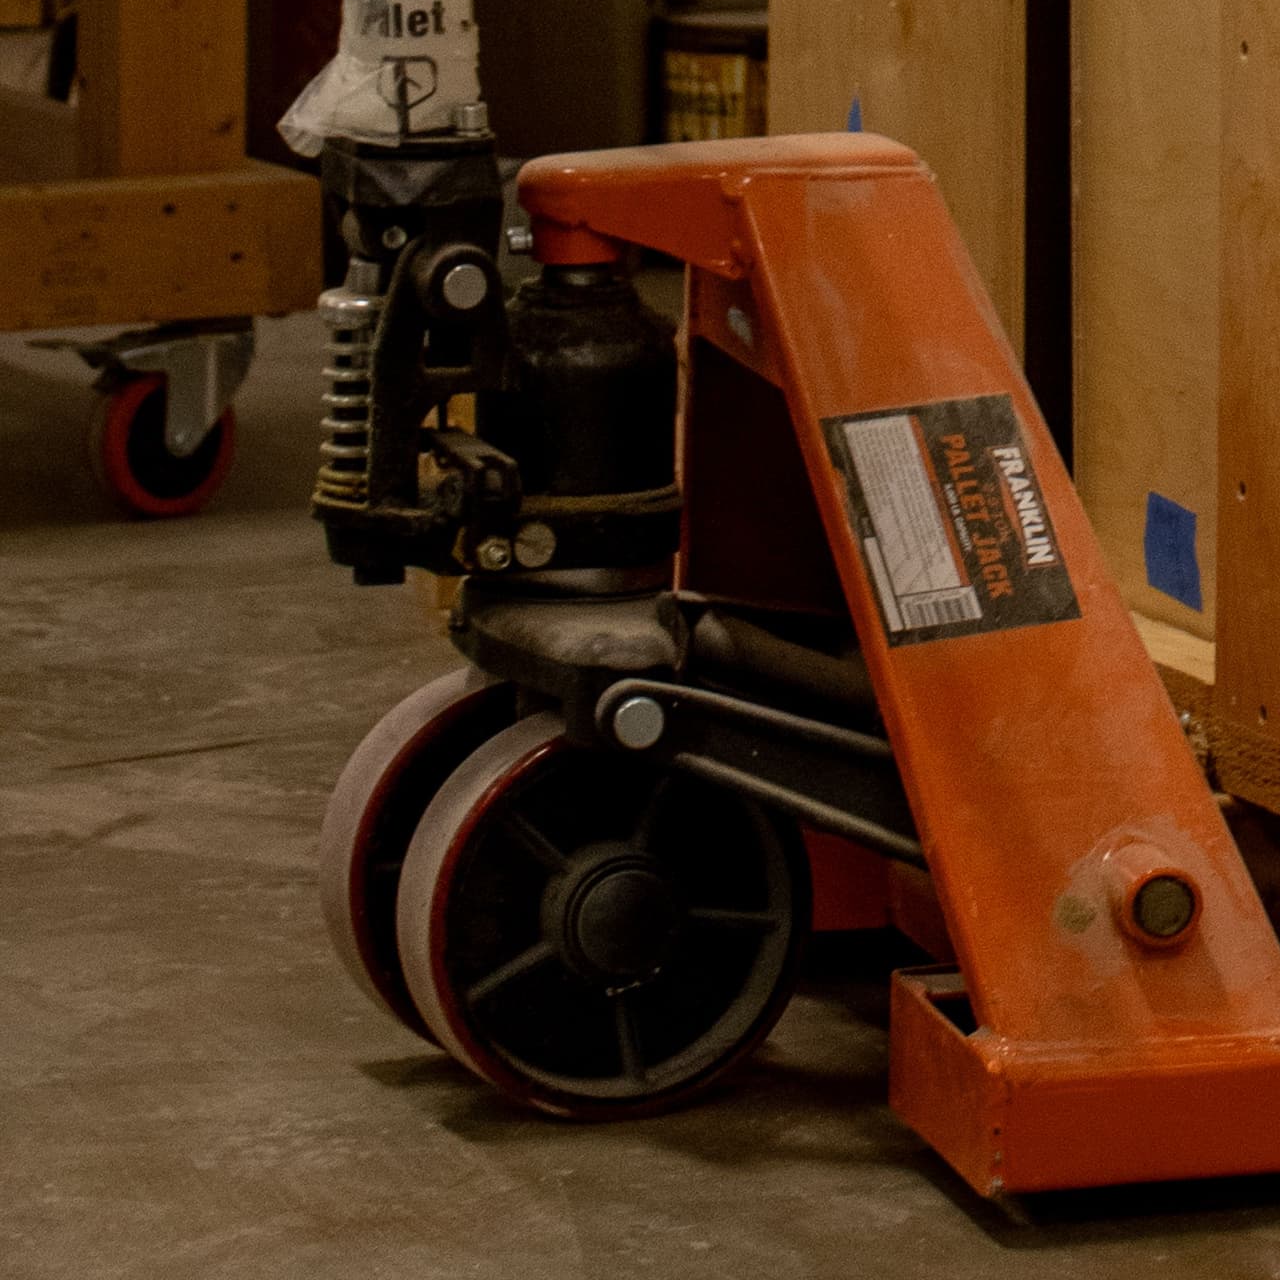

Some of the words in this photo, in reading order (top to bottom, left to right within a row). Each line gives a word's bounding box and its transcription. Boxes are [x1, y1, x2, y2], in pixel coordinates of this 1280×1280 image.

[942, 434, 991, 521] PALLET
[972, 532, 1014, 599] JACK
[992, 447, 1055, 565] FRANKLIN
